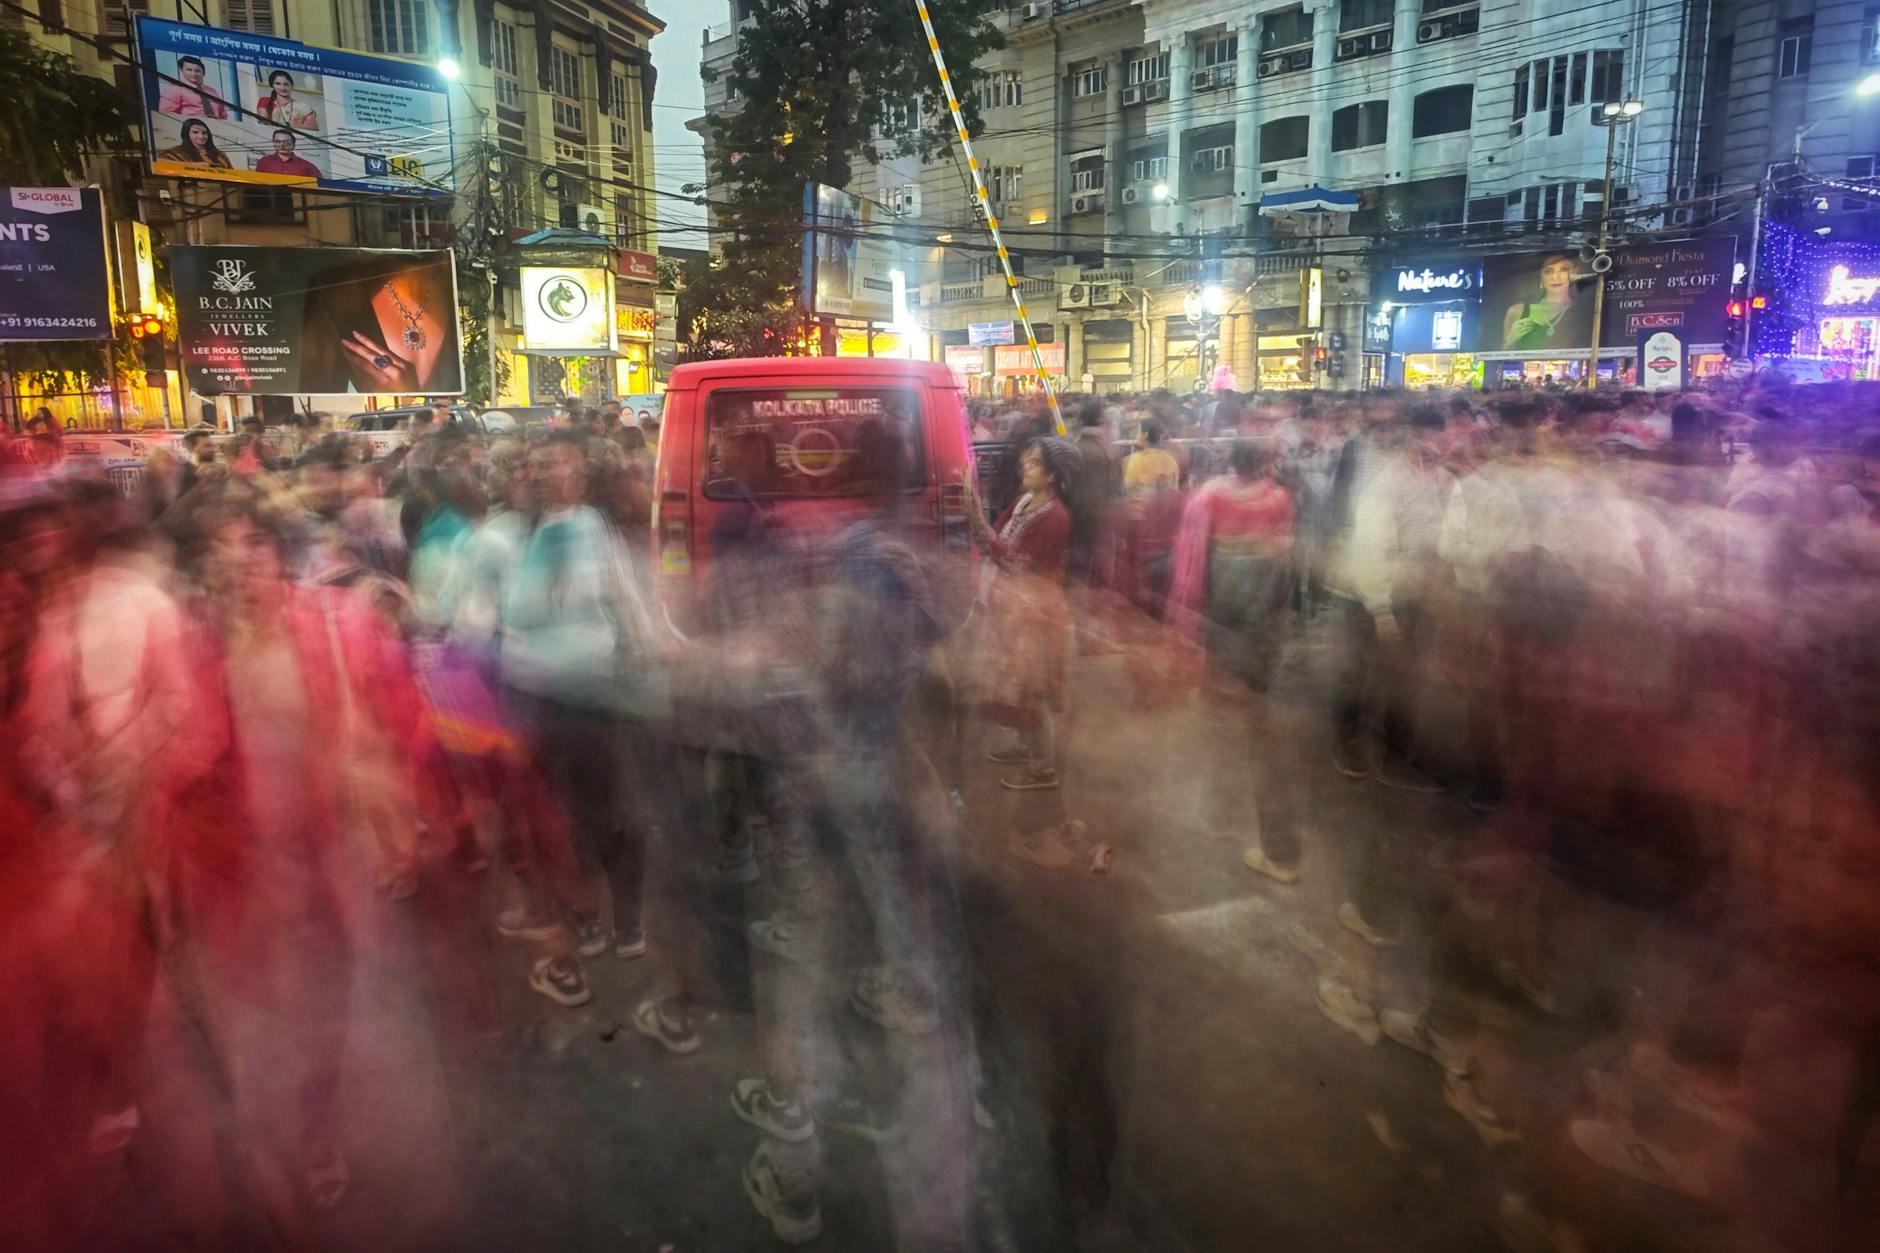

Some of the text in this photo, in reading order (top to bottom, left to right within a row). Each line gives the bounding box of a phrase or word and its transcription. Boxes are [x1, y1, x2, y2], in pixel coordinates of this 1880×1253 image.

[1398, 268, 1472, 293] Nature's
[1628, 277, 1657, 290] OFF
[1667, 274, 1720, 288] 8% OFF
[1619, 300, 1645, 309] 100%
[1, 317, 97, 328] +91 9163424216
[209, 323, 269, 336] VIVEK
[193, 347, 210, 355] LEE
[212, 347, 239, 355] ROAD
